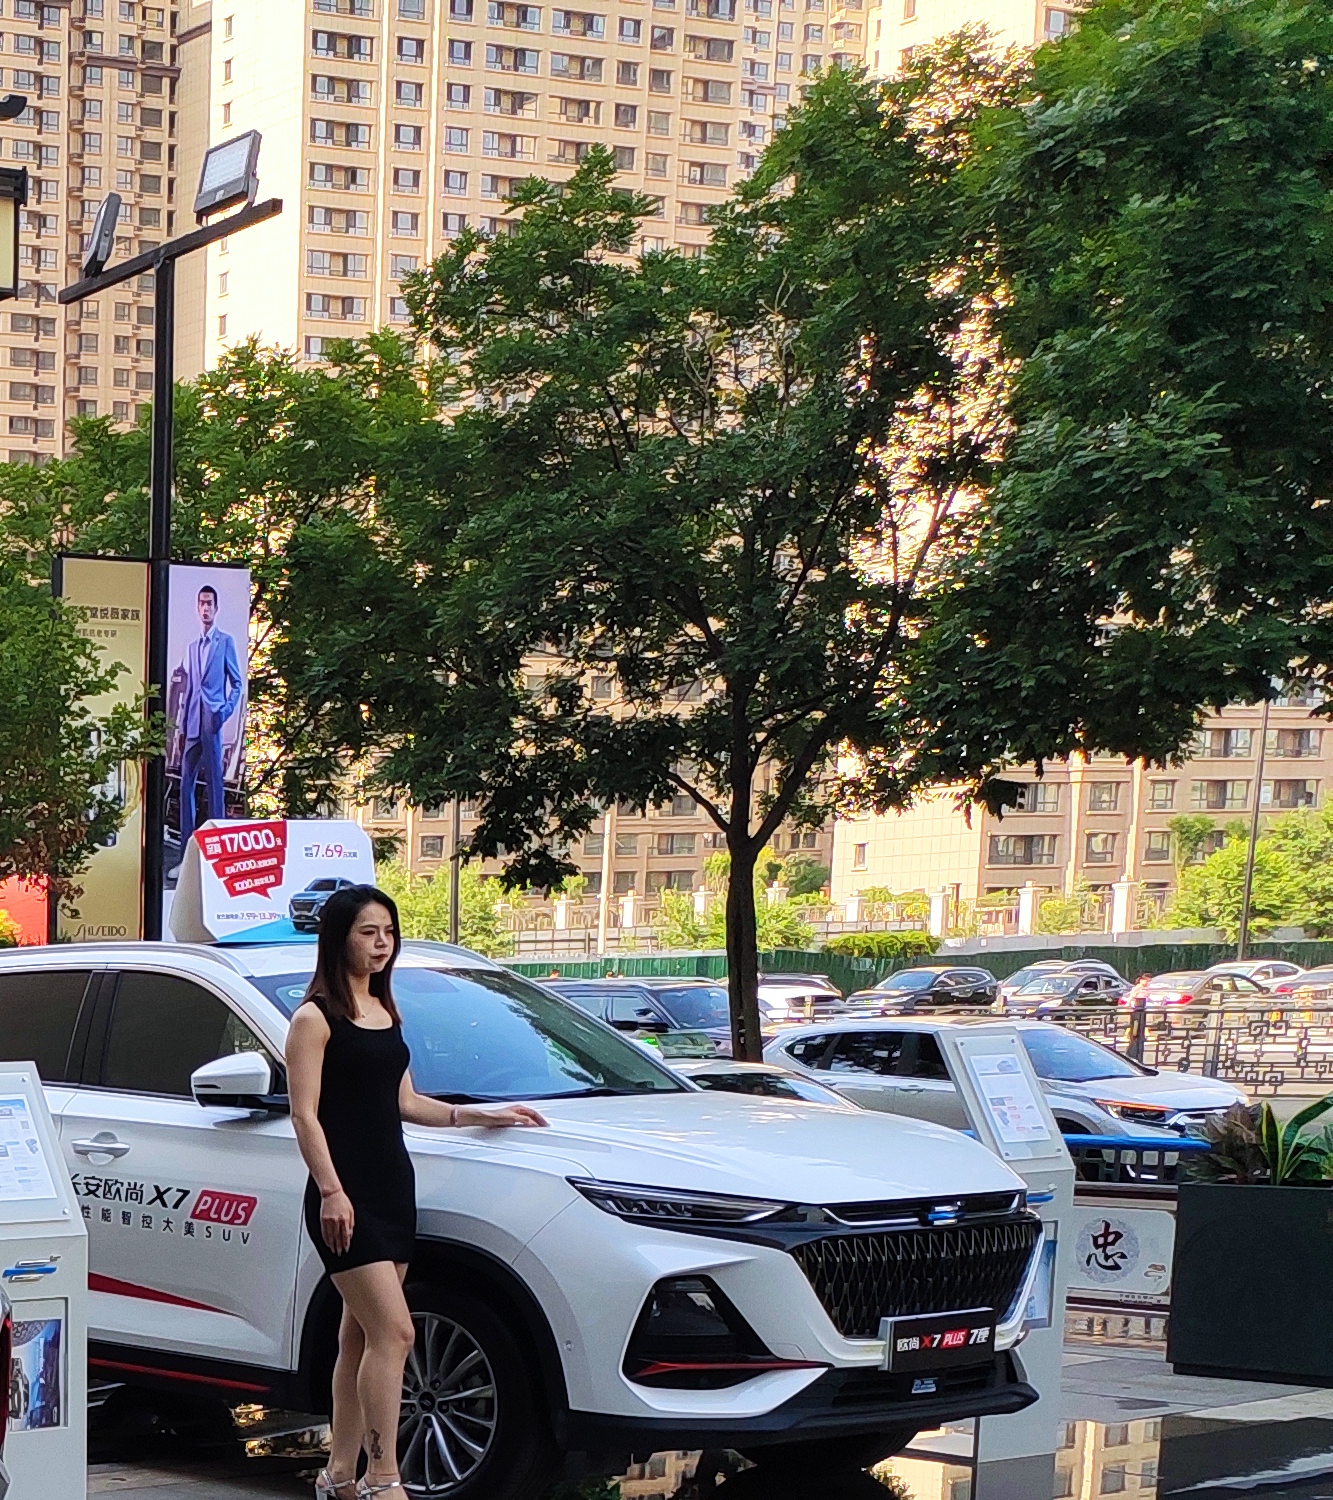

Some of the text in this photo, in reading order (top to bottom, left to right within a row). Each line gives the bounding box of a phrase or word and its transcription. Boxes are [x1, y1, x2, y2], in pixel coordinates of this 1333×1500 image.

[72, 924, 127, 941] SHISEIDO
[194, 1195, 249, 1225] PLUS
[1085, 1219, 1129, 1271] 忠
